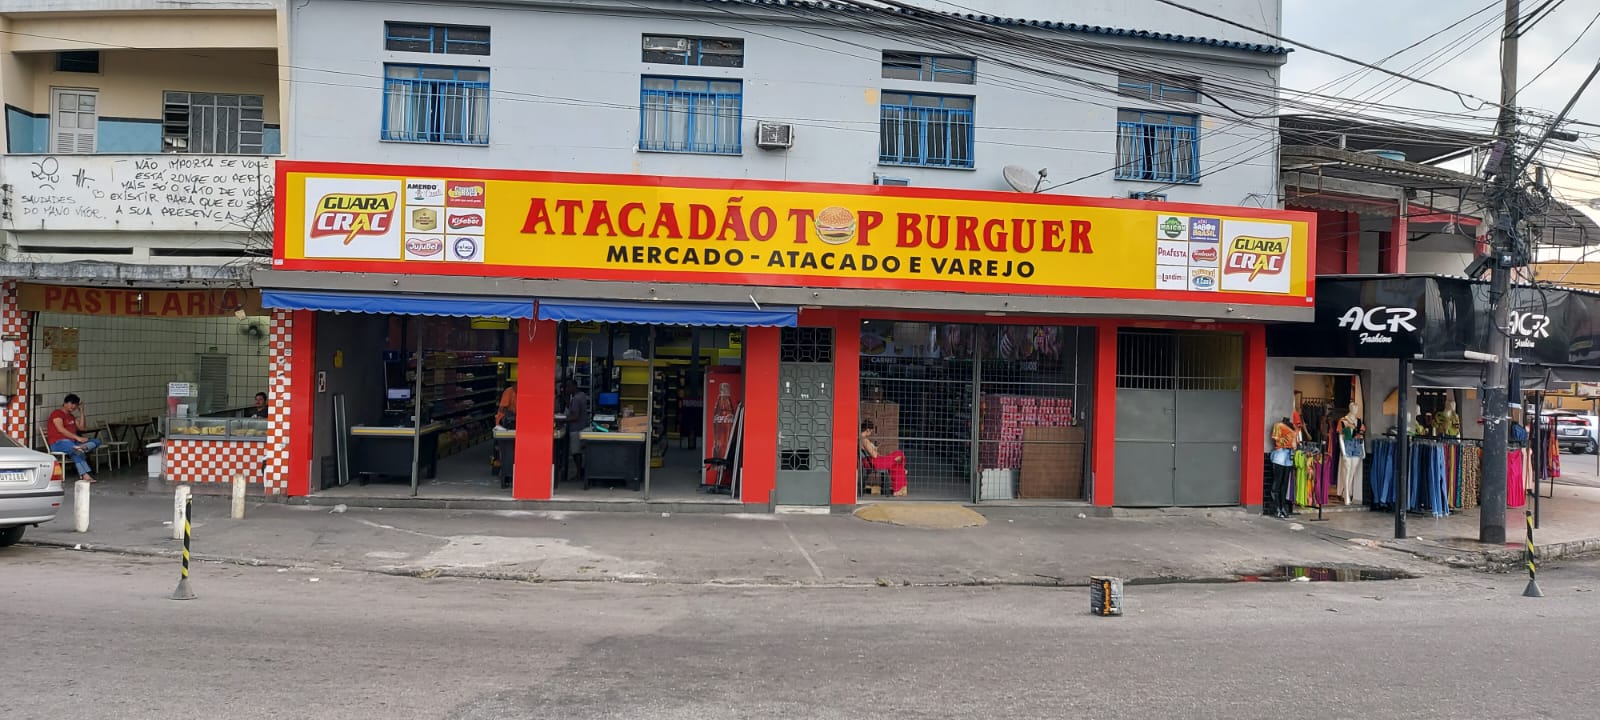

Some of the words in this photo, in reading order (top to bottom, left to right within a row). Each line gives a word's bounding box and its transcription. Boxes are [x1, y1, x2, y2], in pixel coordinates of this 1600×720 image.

[135, 157, 159, 170] NÃO
[169, 158, 213, 170] IMPORTA
[220, 159, 237, 168] SE
[135, 169, 167, 181] ESTÁ
[213, 175, 227, 183] OU
[121, 180, 146, 191] MAIS
[184, 183, 213, 195] FATO
[220, 187, 235, 196] DE
[110, 190, 160, 203] EXISTIR
[167, 193, 195, 205] PARA
[200, 197, 222, 210] QUE
[227, 199, 243, 208] EU
[324, 197, 389, 210] GUARA
[24, 207, 39, 215] DO
[115, 205, 124, 215] A
[129, 206, 153, 216] SUA
[317, 212, 388, 236] CRAC
[520, 197, 778, 244] ATACADÃO
[896, 213, 1093, 254] BURGUER
[1234, 239, 1283, 253] GUARA
[606, 245, 743, 268] MERCADO
[766, 249, 900, 274] ATACADO
[909, 256, 921, 272] E
[931, 257, 1037, 279] VAREJO
[1229, 253, 1281, 275] CRAC
[44, 286, 241, 317] PASTELARIA
[1337, 305, 1418, 333] ACR
[1359, 332, 1392, 345] Fashion
